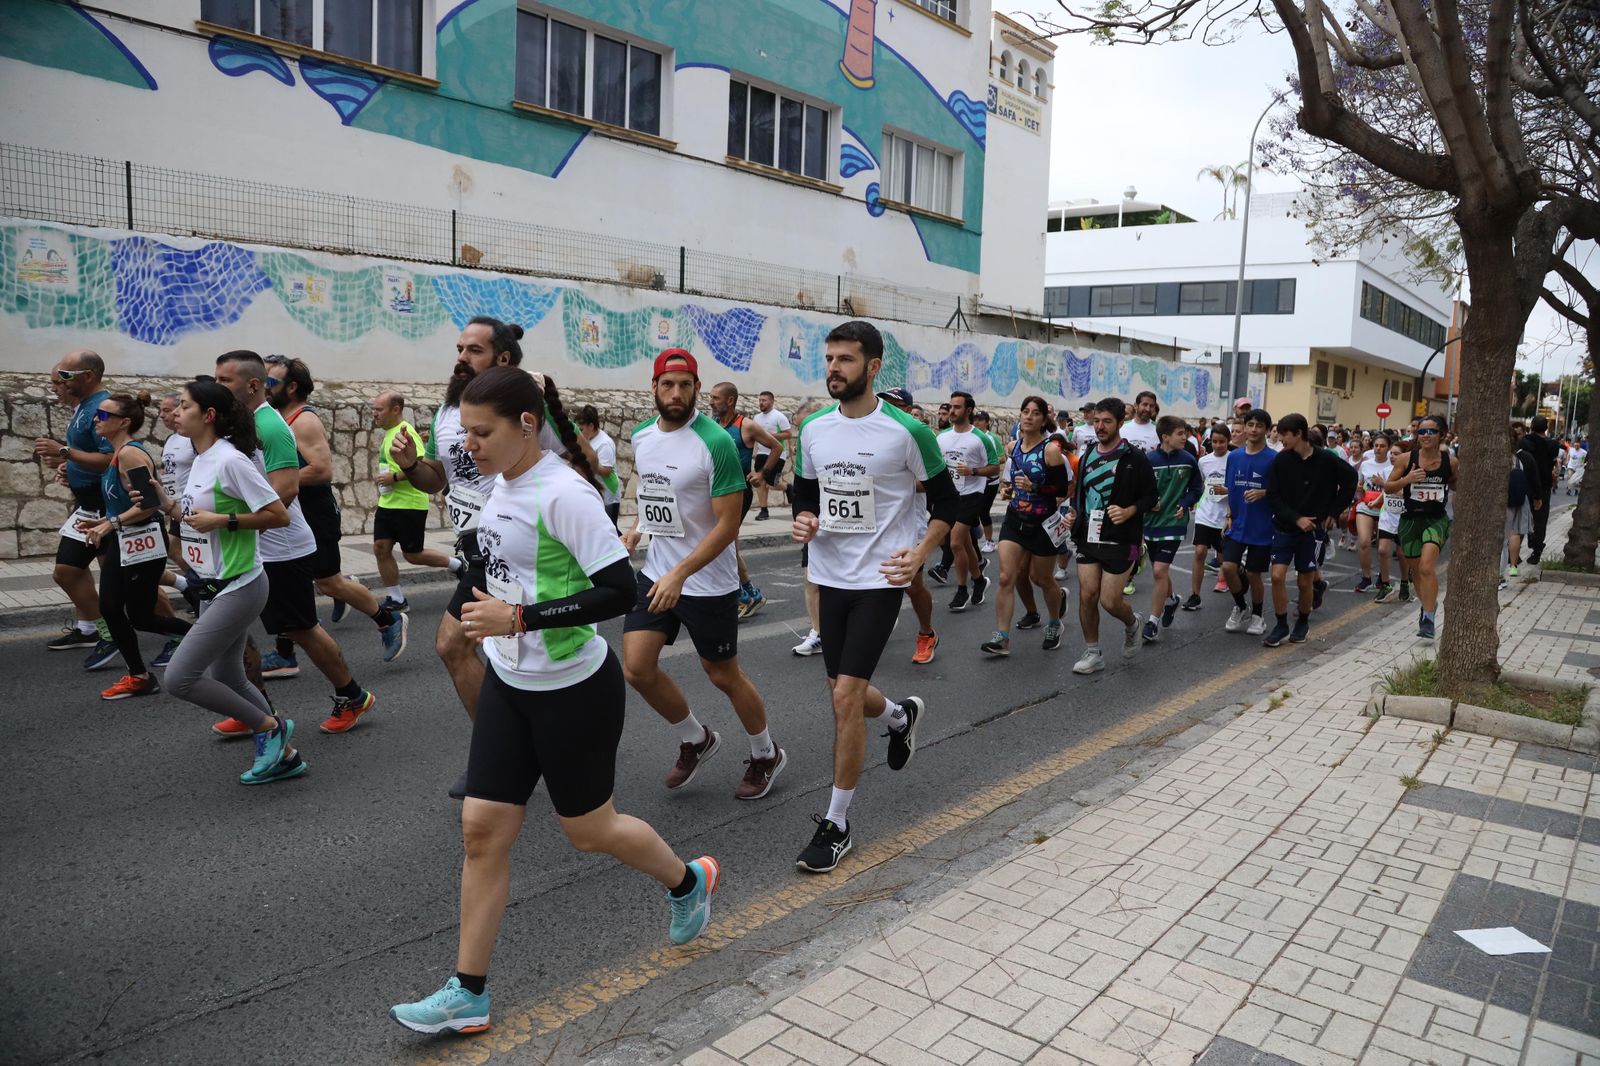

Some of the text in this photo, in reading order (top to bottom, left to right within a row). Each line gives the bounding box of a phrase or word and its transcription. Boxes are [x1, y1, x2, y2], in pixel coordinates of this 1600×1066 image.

[998, 105, 1016, 122] SAFA
[1024, 117, 1040, 131] ICET
[1387, 500, 1403, 508] 650
[1417, 491, 1438, 501] 311
[645, 504, 673, 524] 600
[828, 498, 864, 519] 661
[125, 535, 156, 554] 280
[187, 545, 204, 564] 92
